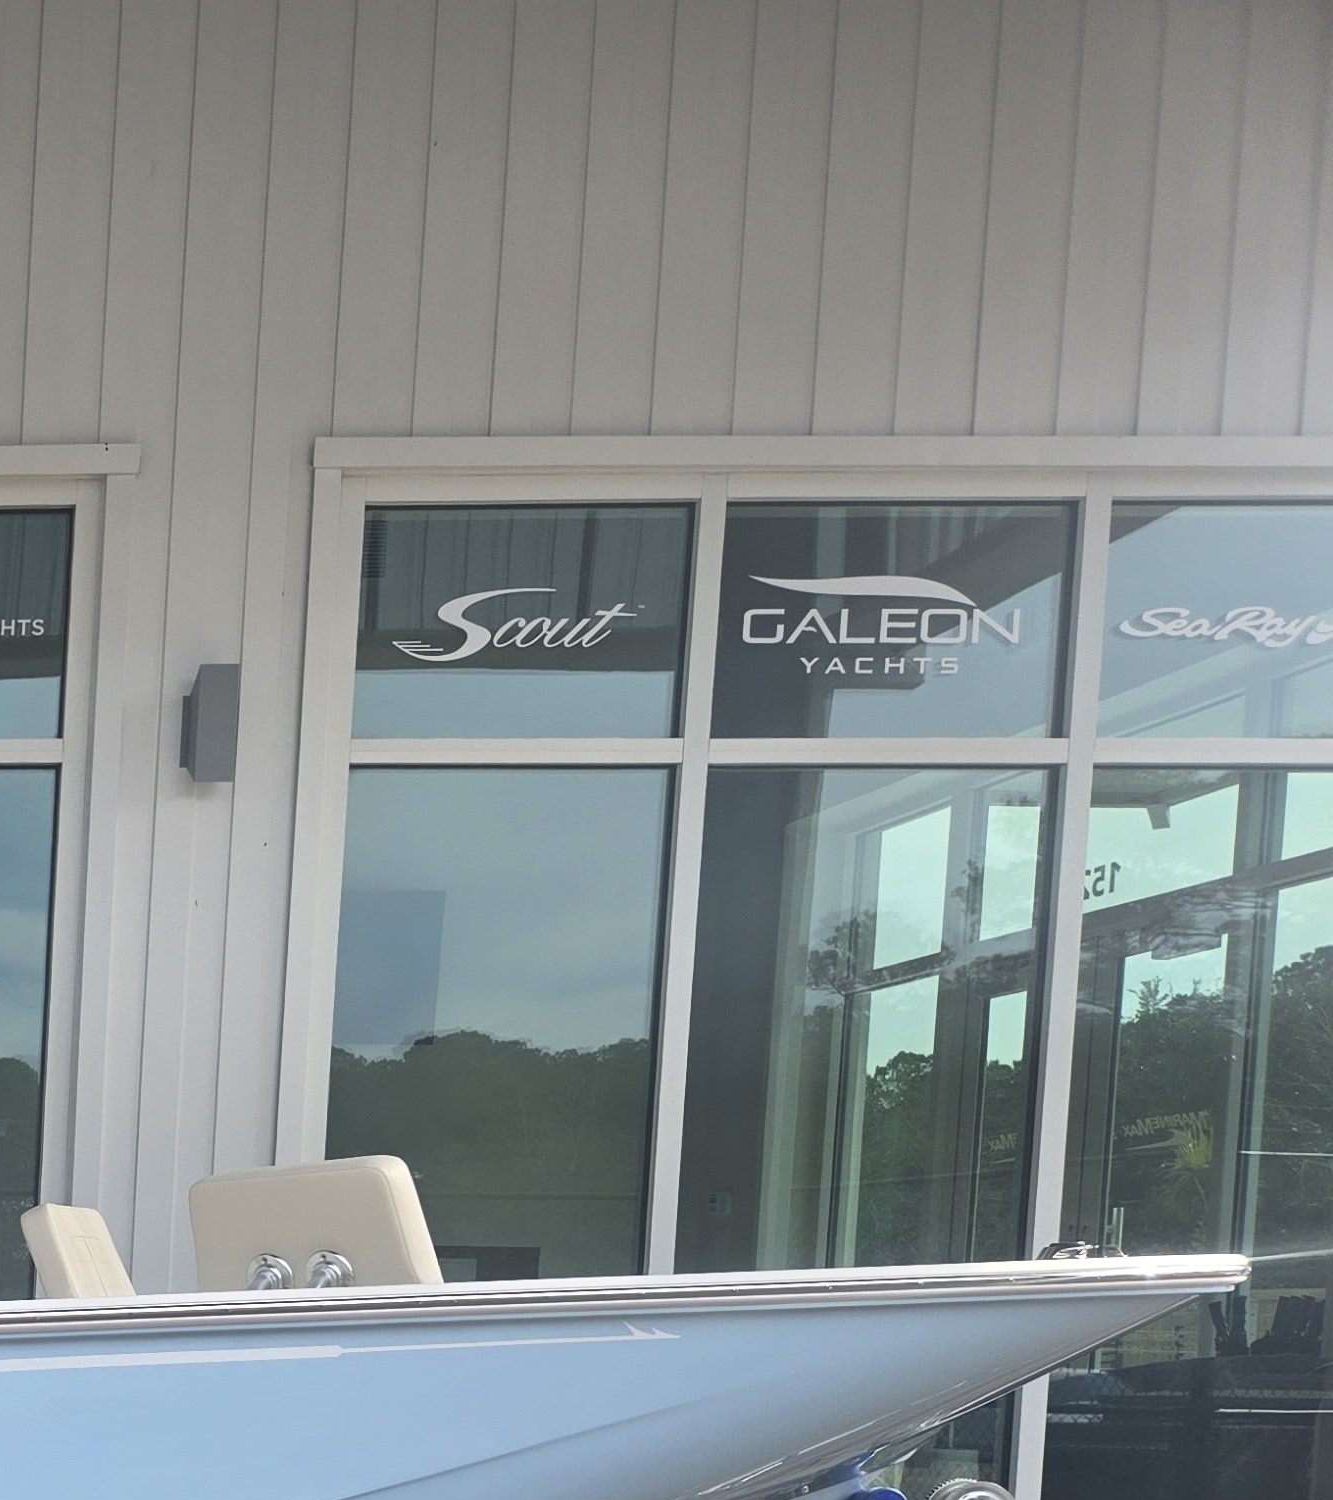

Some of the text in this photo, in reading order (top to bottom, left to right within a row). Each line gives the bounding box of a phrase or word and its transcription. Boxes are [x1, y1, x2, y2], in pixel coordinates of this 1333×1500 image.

[391, 586, 638, 662] Scout
[741, 608, 1021, 644] GALEON
[1119, 605, 1318, 649] Sea Ray
[799, 657, 959, 675] YACHTS
